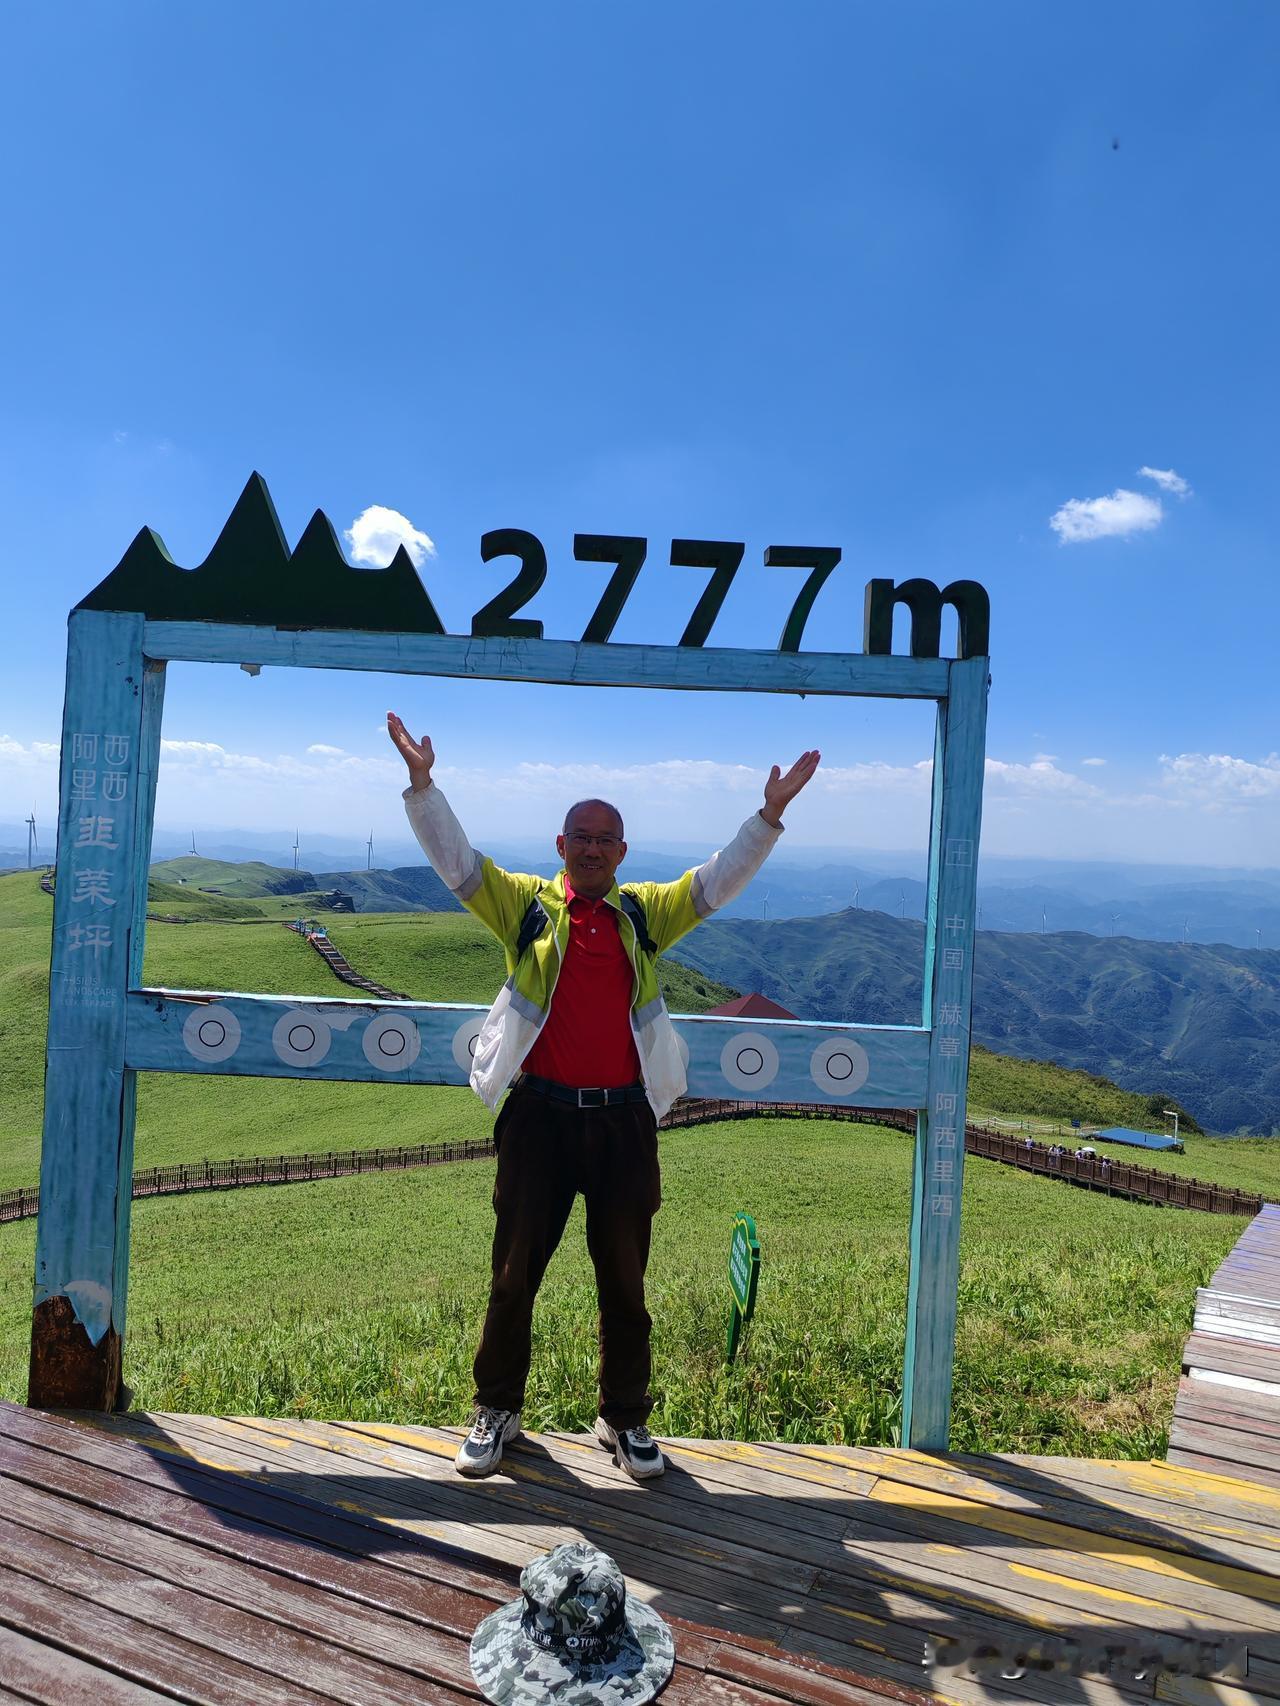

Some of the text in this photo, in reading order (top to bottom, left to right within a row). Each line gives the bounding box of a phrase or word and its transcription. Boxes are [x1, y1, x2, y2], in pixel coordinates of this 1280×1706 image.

[68, 815, 119, 961] 韭菜坪
[931, 913, 966, 1217] 中国 赫章 阿西里西
